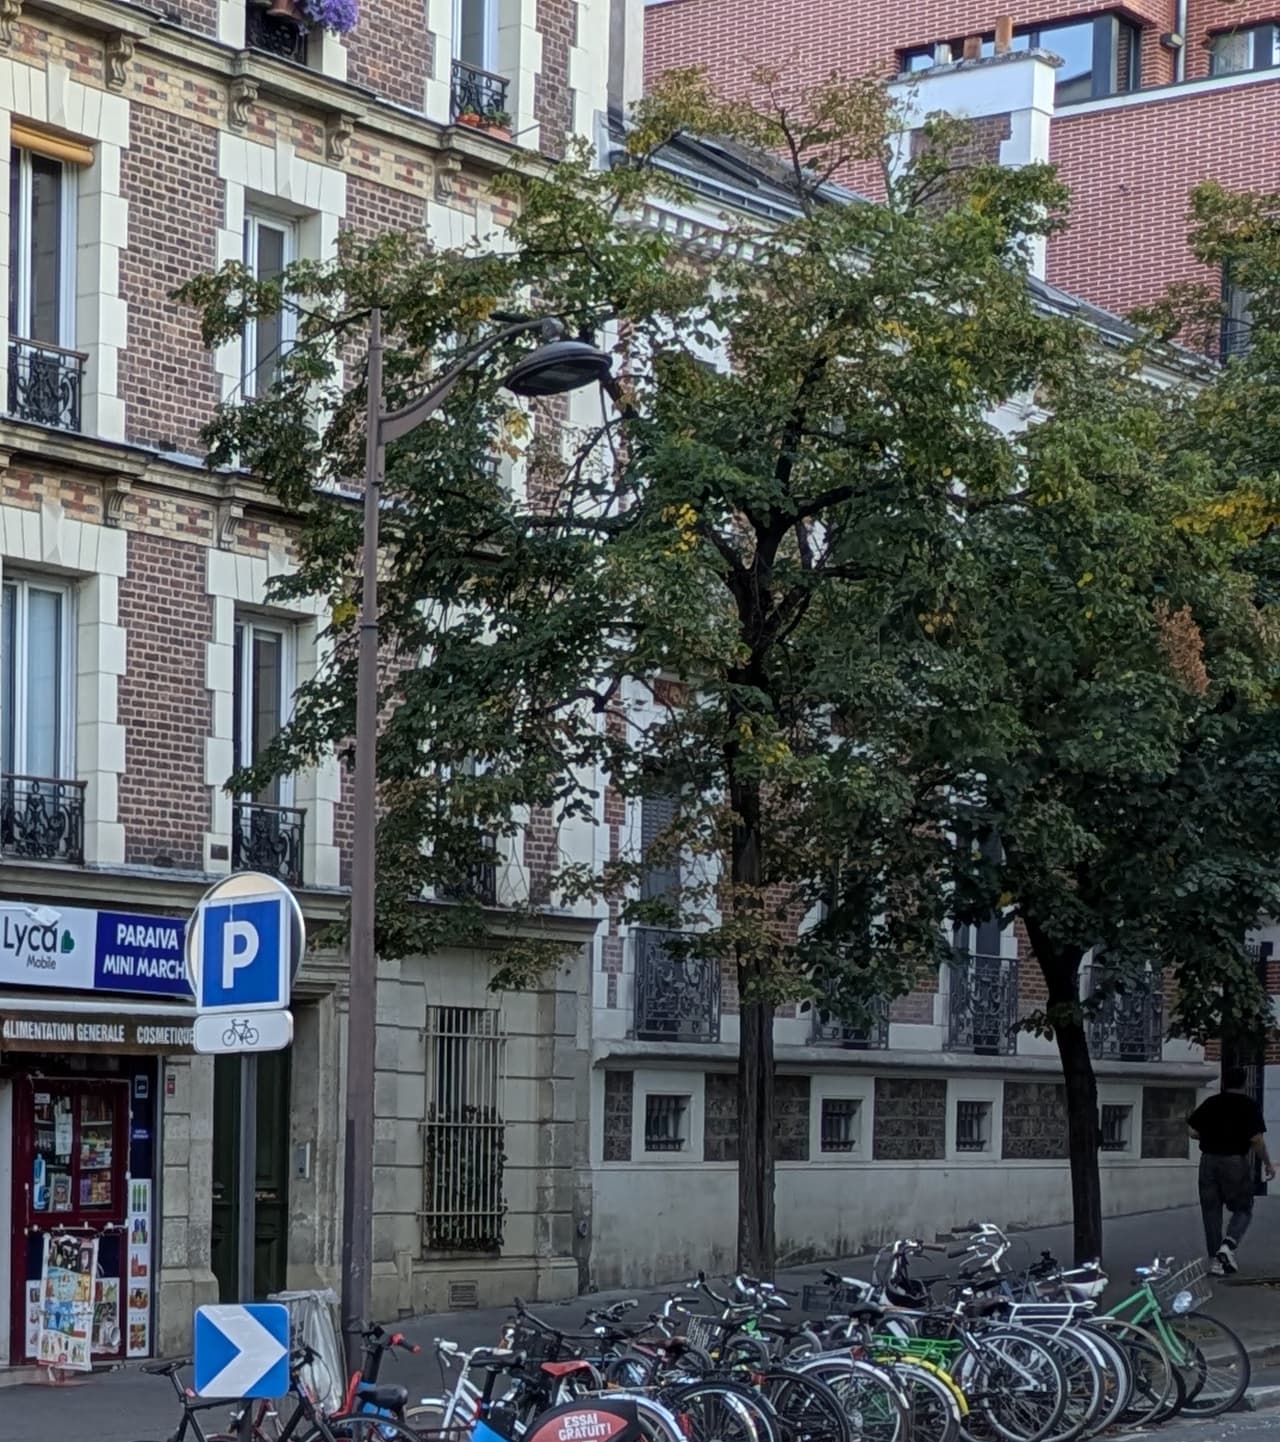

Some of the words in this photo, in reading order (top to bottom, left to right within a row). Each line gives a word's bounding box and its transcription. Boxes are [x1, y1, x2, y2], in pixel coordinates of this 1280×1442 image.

[3, 916, 57, 955] Lyca
[116, 923, 179, 950] PARAIVA
[26, 954, 56, 970] Mobile
[103, 954, 135, 976] MINI
[137, 958, 189, 980] MARCH
[222, 920, 260, 990] P
[2, 1018, 74, 1040] ALIMENTATION
[76, 1022, 125, 1043] GENERALE
[563, 1412, 598, 1429] ESSAI
